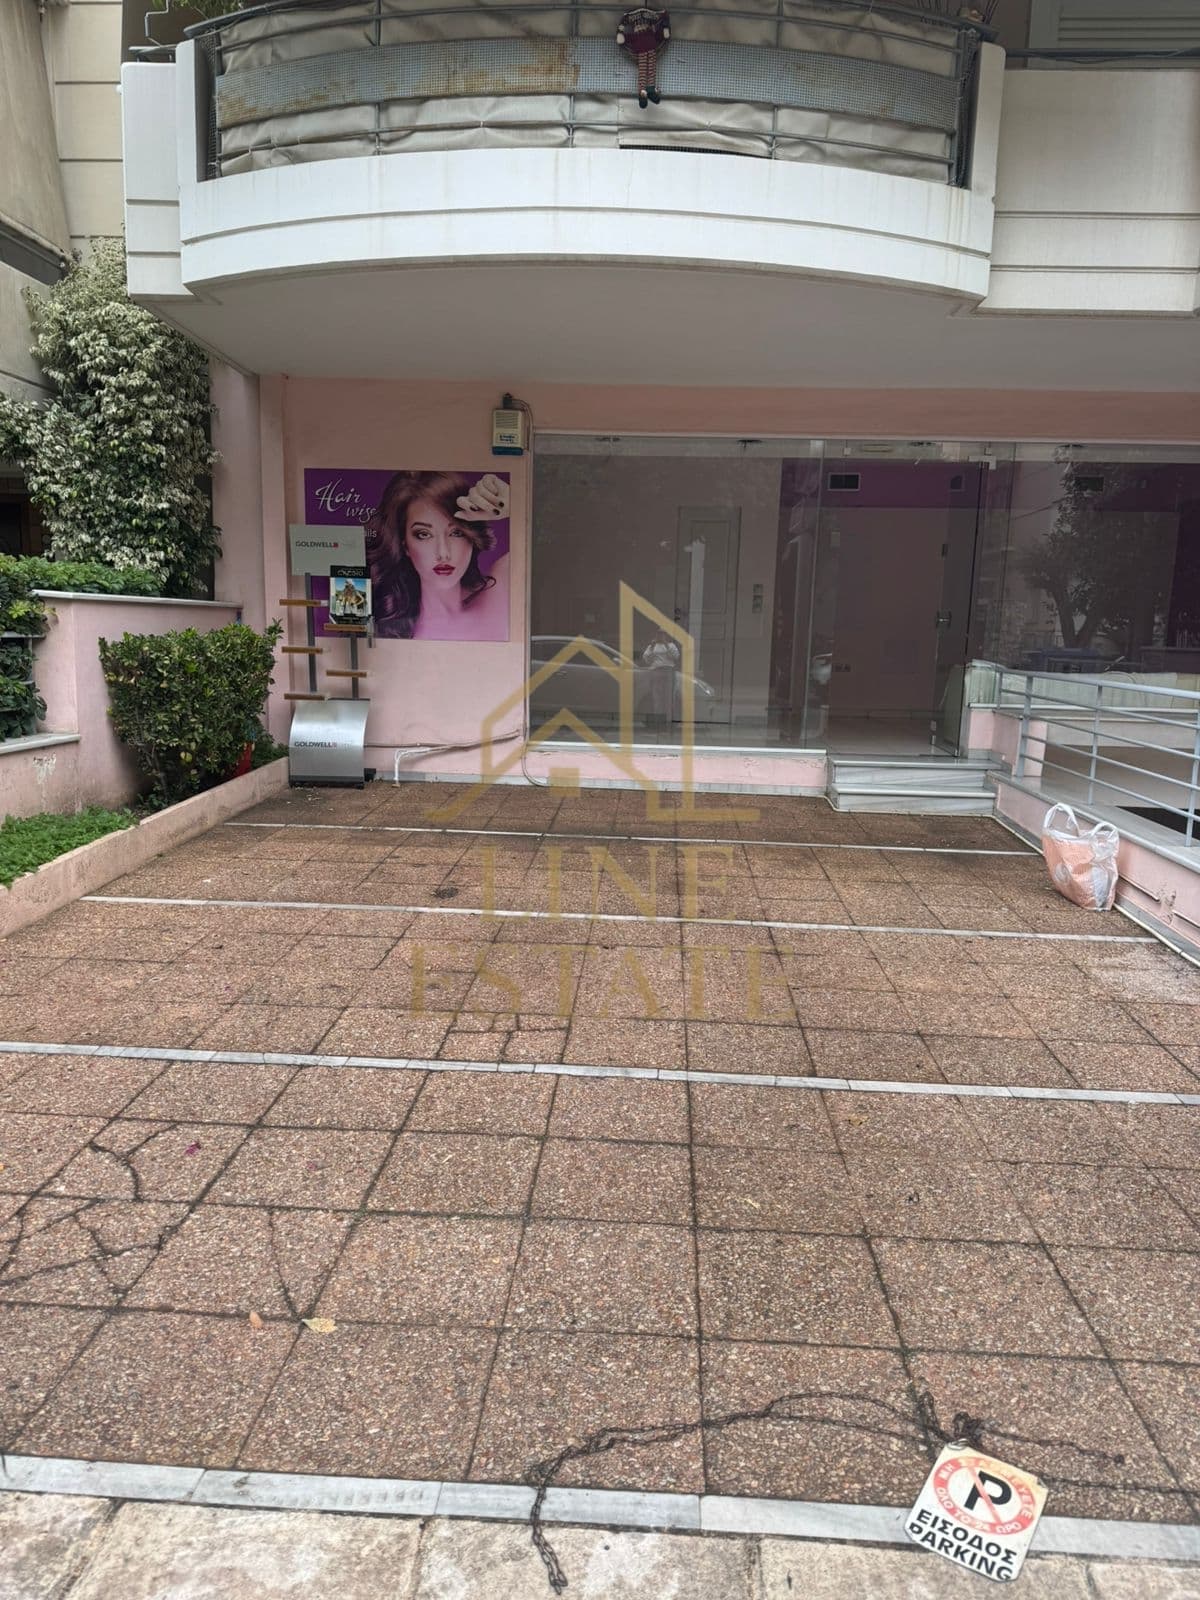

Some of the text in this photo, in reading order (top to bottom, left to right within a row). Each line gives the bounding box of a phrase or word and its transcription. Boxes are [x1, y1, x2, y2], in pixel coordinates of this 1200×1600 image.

[314, 478, 361, 511] Hair
[346, 504, 377, 523] wise
[916, 1509, 1018, 1566] ΕΙΣΟΔΟΣ
